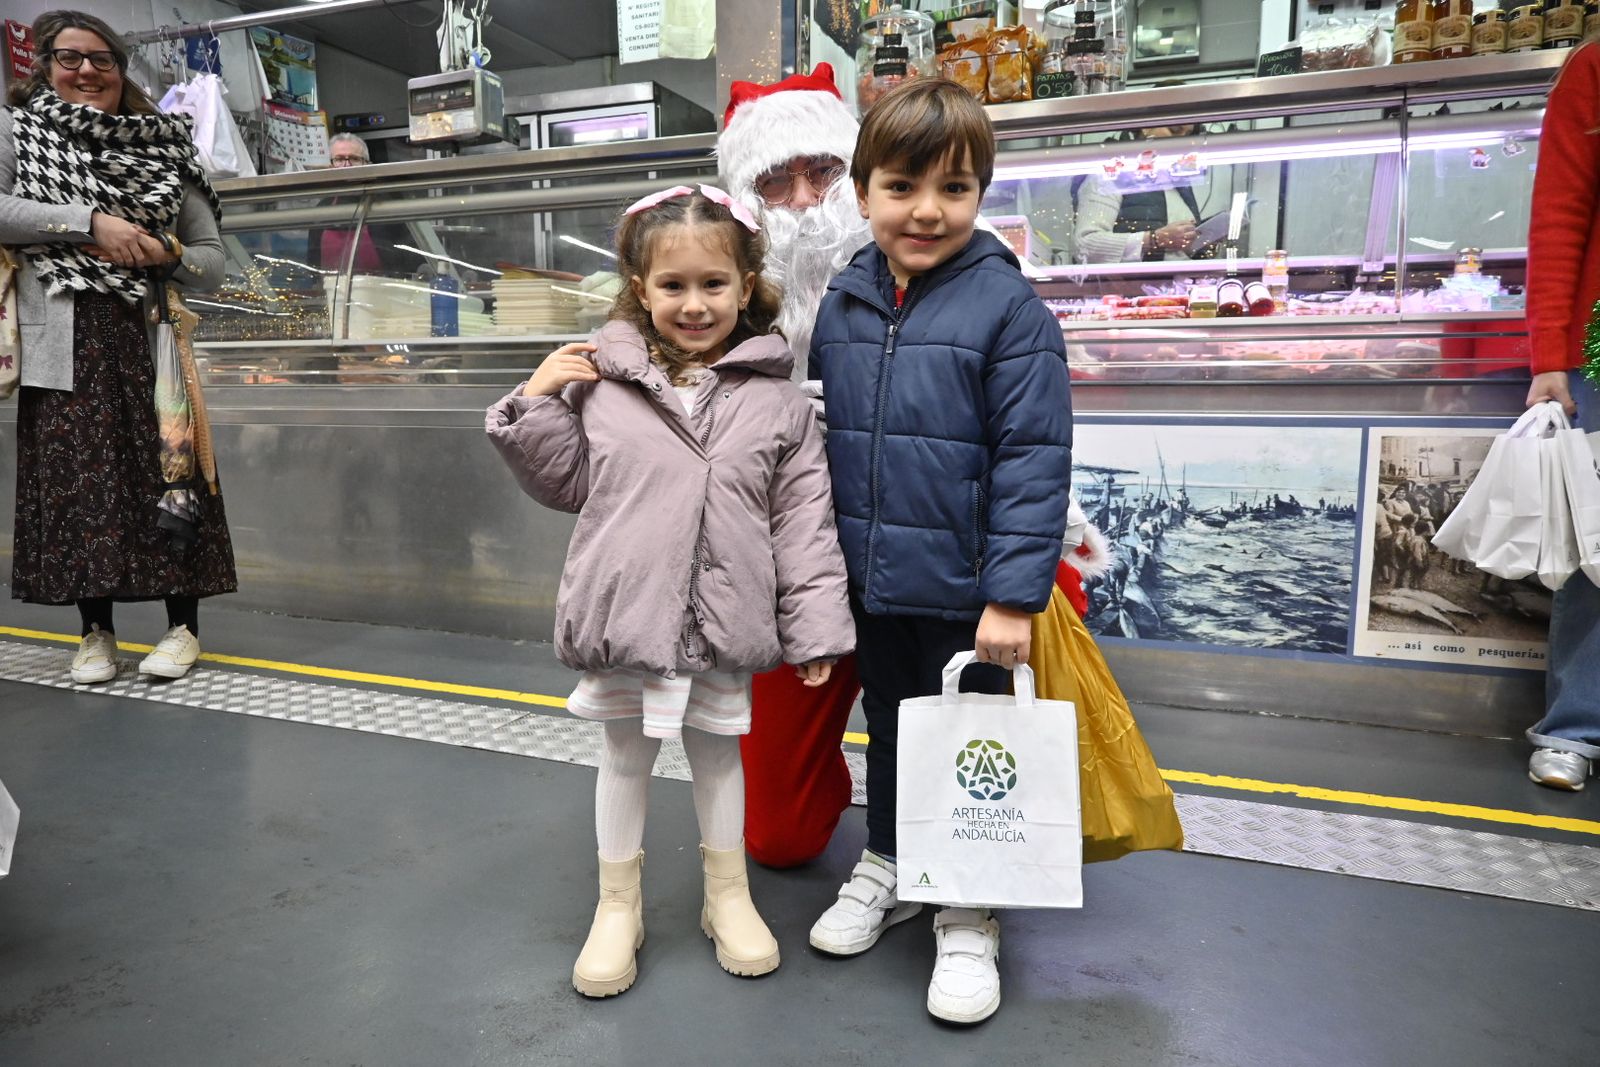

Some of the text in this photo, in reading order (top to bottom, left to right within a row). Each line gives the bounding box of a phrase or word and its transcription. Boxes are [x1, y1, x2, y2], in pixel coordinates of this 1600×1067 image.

[625, 34, 644, 42] VENTA
[1037, 73, 1072, 81] PATATAS
[1404, 641, 1422, 650] así
[1433, 644, 1465, 653] como
[1478, 647, 1545, 659] pesquerías
[951, 807, 1025, 821] ARTESANÍA
[967, 820, 1009, 830] HECHA EN
[951, 828, 1026, 843] ANDALUCÍA
